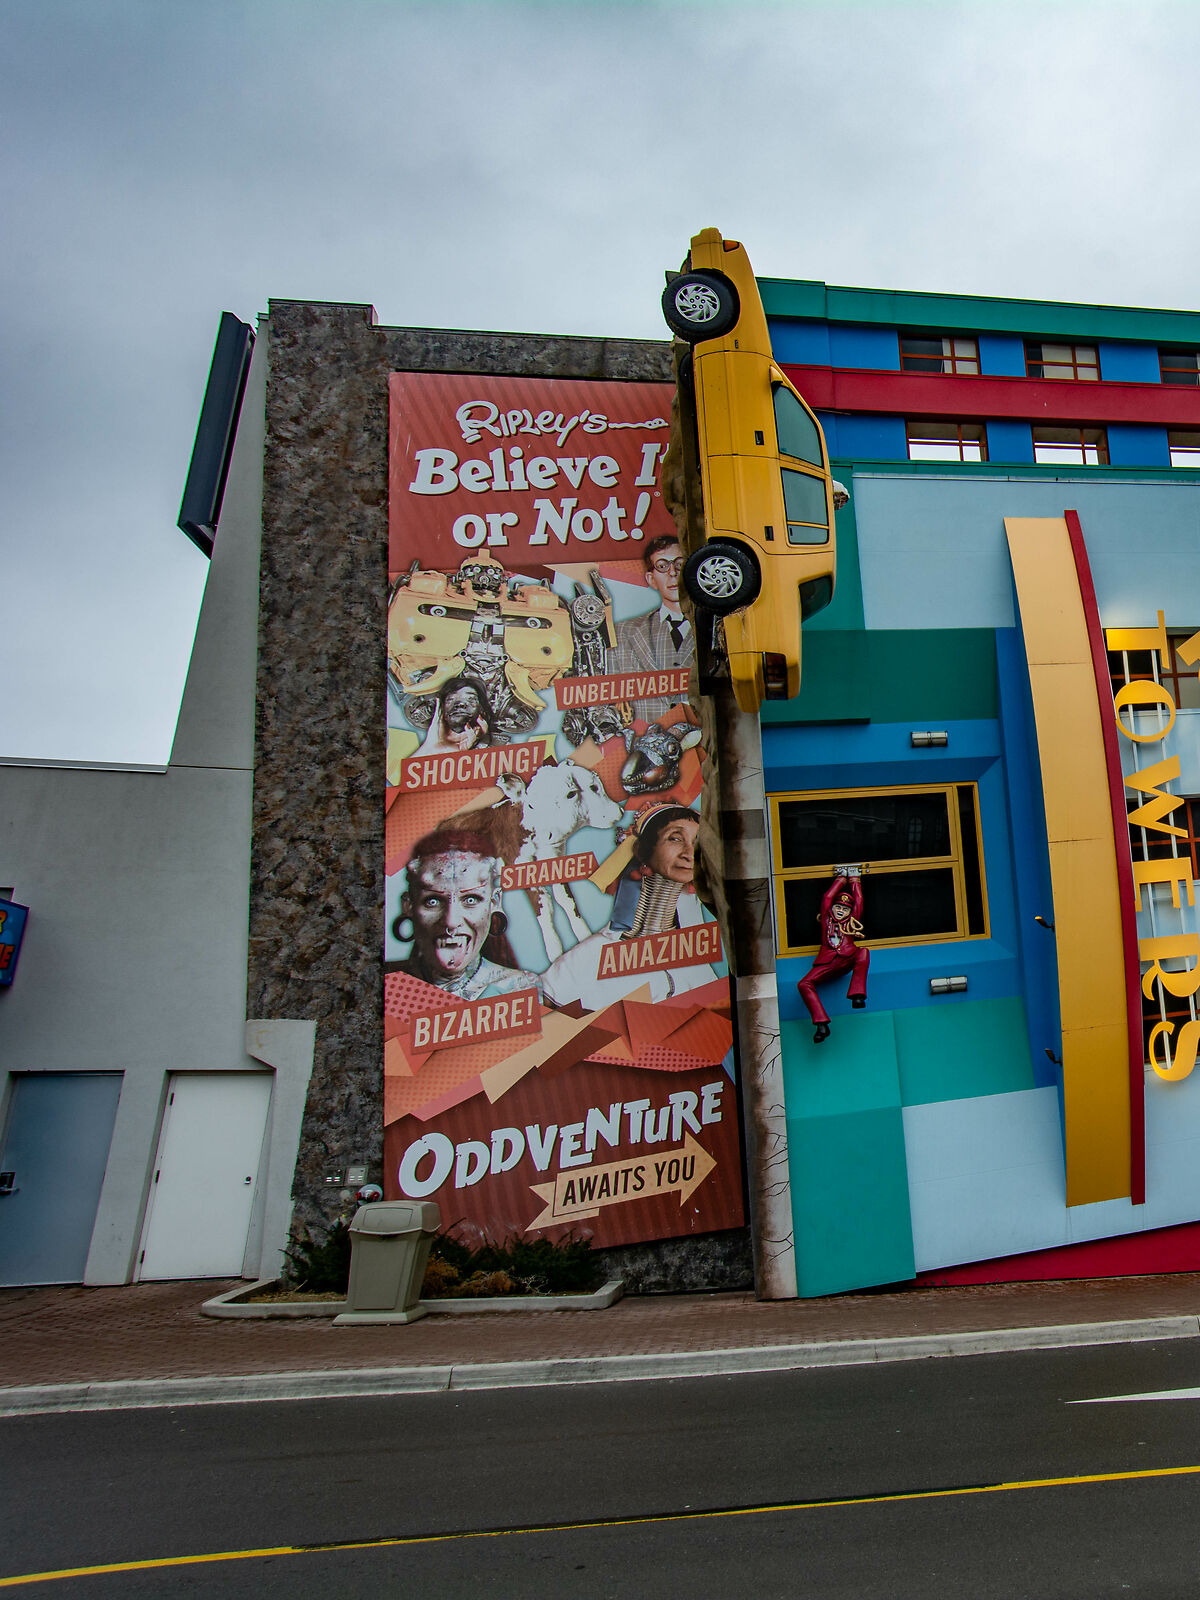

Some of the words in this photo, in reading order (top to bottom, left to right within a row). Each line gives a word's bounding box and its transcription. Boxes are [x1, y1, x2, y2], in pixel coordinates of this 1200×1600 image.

[408, 446, 621, 495] Believe
[452, 511, 519, 548] or
[528, 491, 652, 545] Not!
[562, 672, 690, 706] UNBELIEVABLE
[406, 745, 540, 790] SHOCKING!
[502, 854, 594, 889] STRANGE!
[601, 927, 718, 975] AMAZING!
[413, 996, 534, 1048] BIZARRE!
[398, 1081, 724, 1198] ODDVENTURE
[562, 1164, 646, 1207] AWAITS
[654, 1155, 696, 1187] YOU
